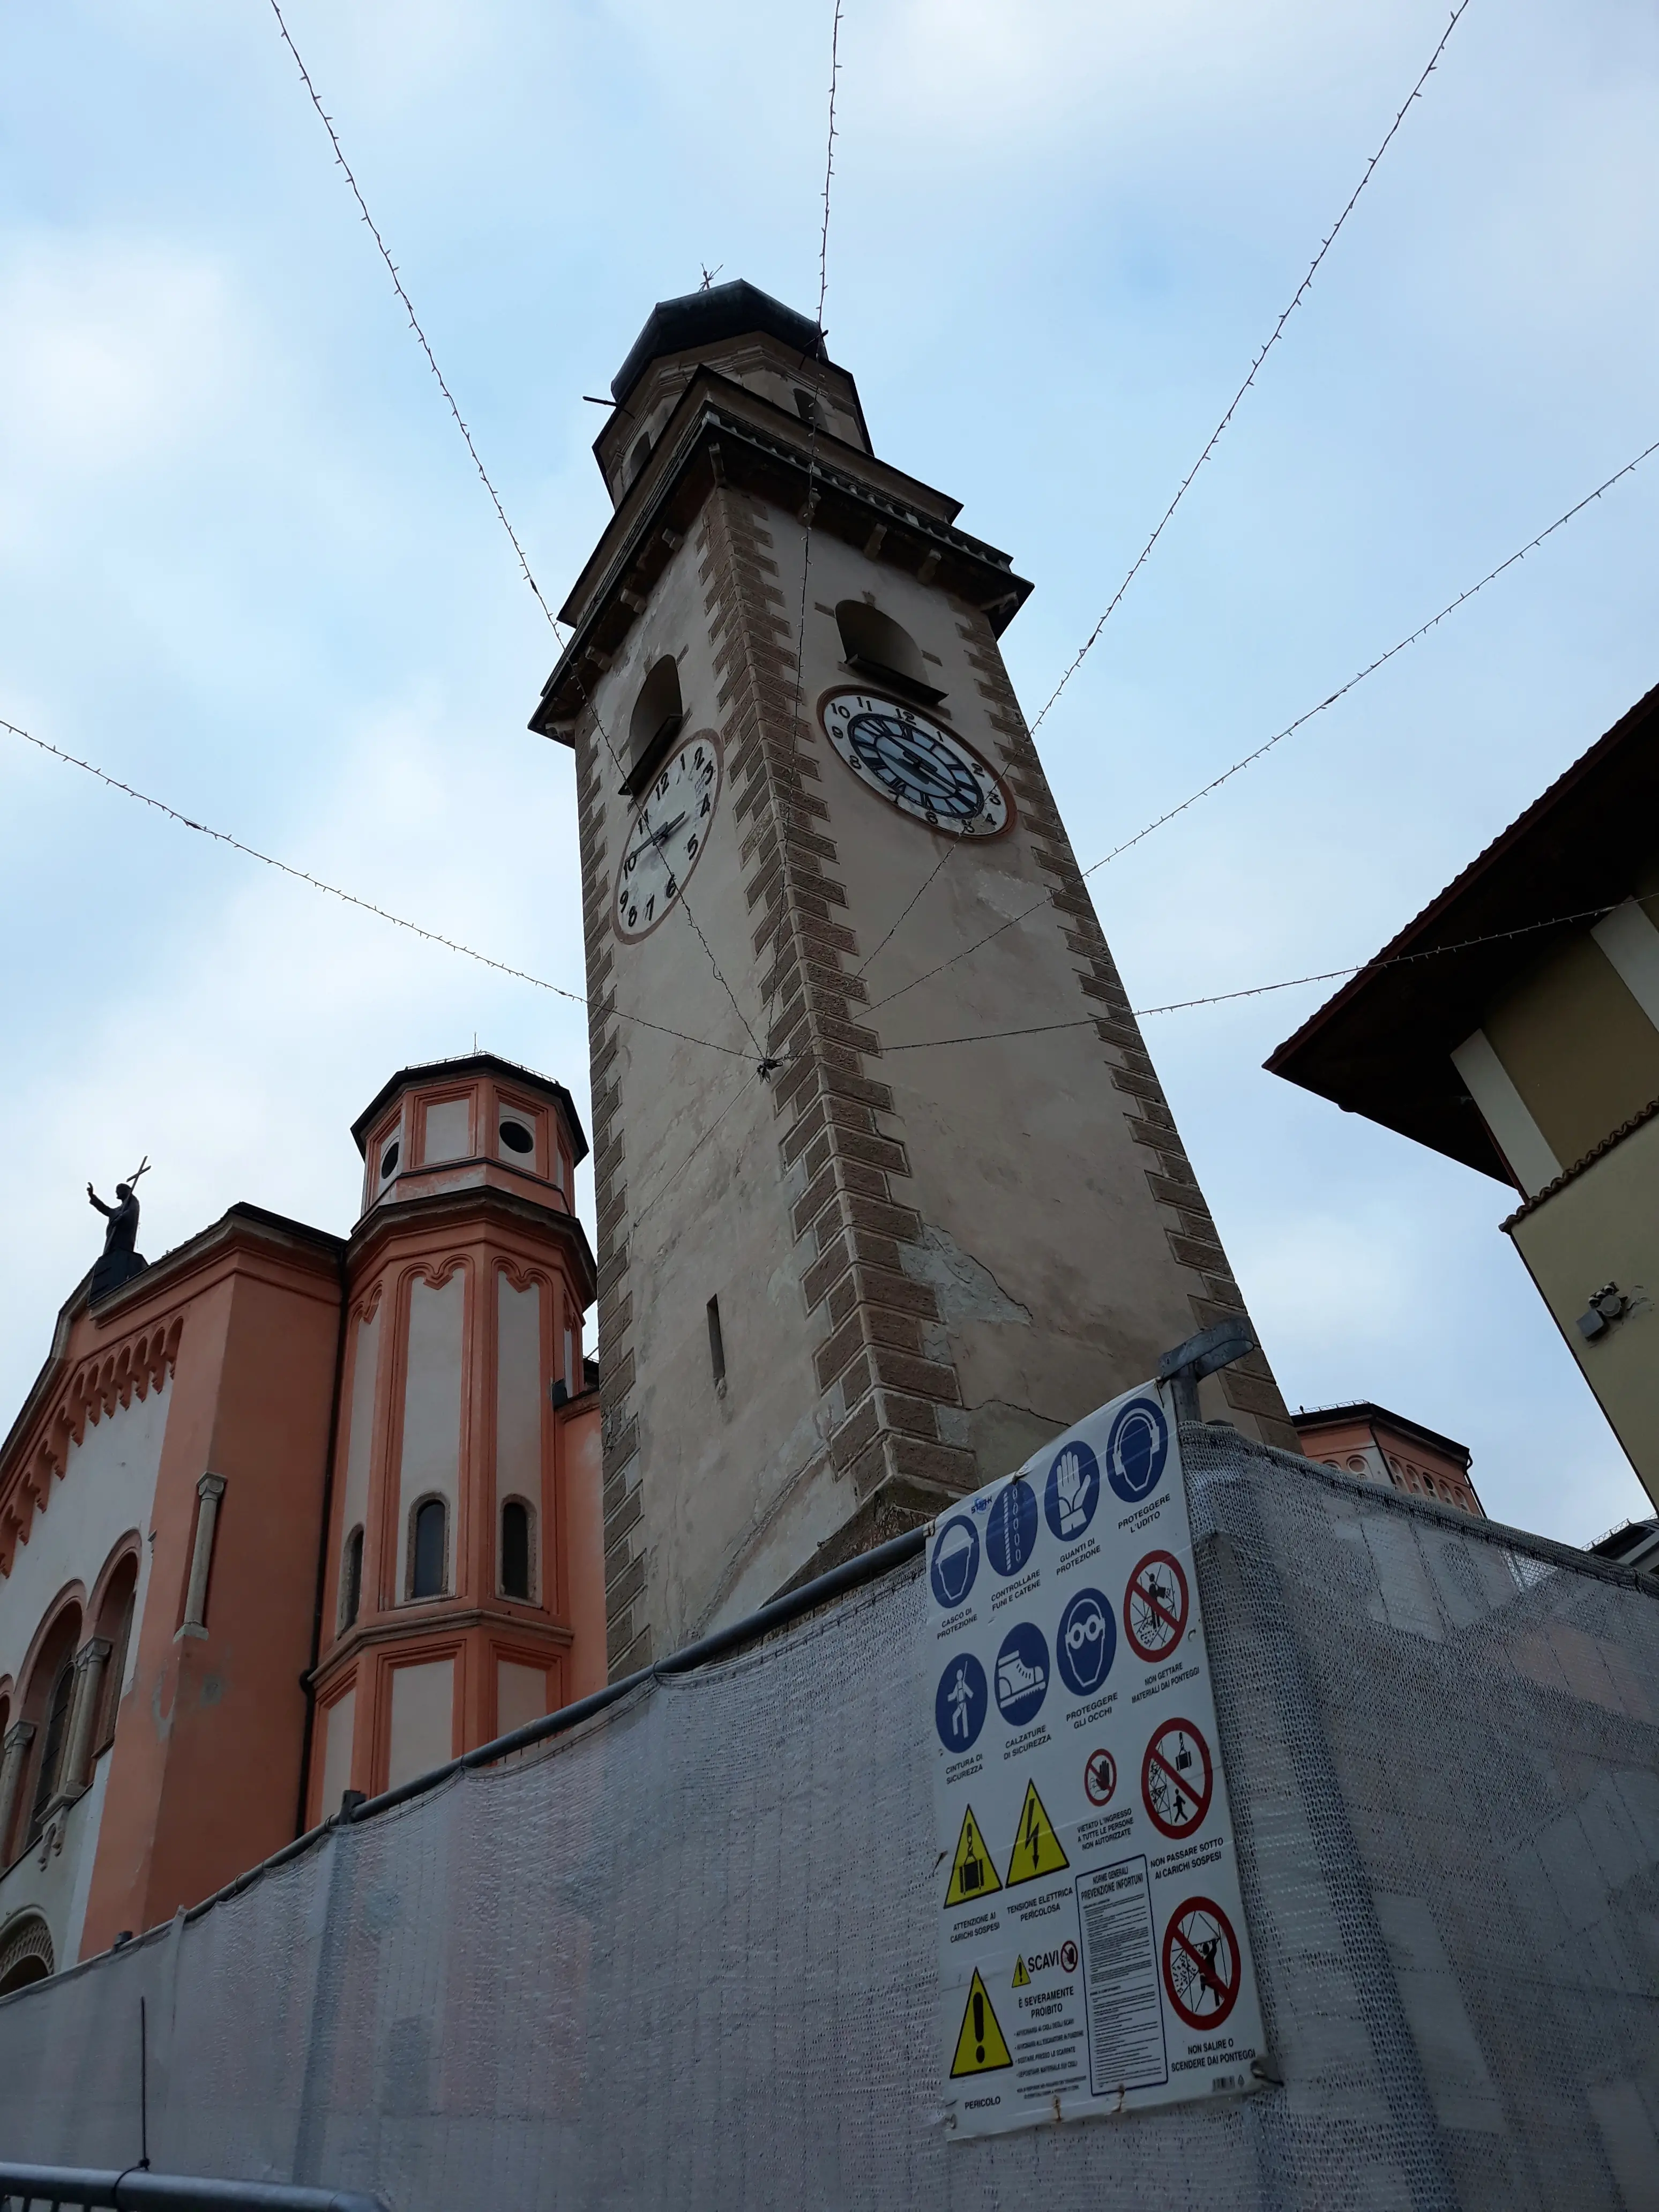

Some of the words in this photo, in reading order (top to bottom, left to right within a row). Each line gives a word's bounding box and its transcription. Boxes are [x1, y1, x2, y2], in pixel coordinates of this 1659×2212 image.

[831, 703, 850, 719] 10
[857, 697, 872, 712] 11
[895, 708, 916, 726] 12
[832, 726, 843, 739] 9
[936, 731, 944, 742] 1
[680, 753, 685, 771] 1
[694, 746, 705, 771] 2
[849, 755, 862, 769] 8
[703, 760, 713, 785] 3
[971, 763, 985, 778] 2
[656, 772, 669, 801] 12
[888, 789, 899, 804] 7
[988, 791, 1001, 805] 3
[700, 793, 711, 817] 4
[638, 808, 649, 835] 11
[926, 811, 938, 824] 6
[961, 819, 975, 833] 5
[986, 813, 997, 825] 4
[687, 833, 698, 860] 5
[623, 851, 637, 880] 10
[666, 874, 676, 898] 6
[620, 890, 629, 913] 9
[646, 893, 654, 921] 7
[628, 906, 637, 927] 8
[1118, 1493, 1171, 1529] PROTEGGERE
[1130, 1511, 1161, 1533] L'UDITO
[1056, 1545, 1101, 1575] PROTEZIONE
[1060, 1542, 1086, 1563] GUANTI
[1088, 1537, 1095, 1546] DI
[991, 1568, 1041, 1602] CONTROLLARE
[992, 1598, 1007, 1611] FUNI
[1015, 1580, 1041, 1598] CATENE
[937, 1613, 977, 1640] PROTEZIONE
[941, 1612, 964, 1627] CASCO
[965, 1607, 972, 1616] DI
[1132, 1684, 1160, 1704] MATERIALI
[1161, 1680, 1170, 1691] DAI
[1171, 1667, 1200, 1686] PONTEGGI
[1145, 1675, 1156, 1686] NON
[1157, 1662, 1183, 1680] GETTARE
[1066, 1692, 1118, 1722] PROTEGGERE
[1074, 1719, 1086, 1729] GLI
[1088, 1706, 1112, 1723] OCCHI
[1004, 1752, 1011, 1760] DI
[1012, 1734, 1051, 1757] SICUREZZA
[1005, 1725, 1047, 1748] CALZATURE
[946, 1757, 974, 1775] CINTURA
[976, 1753, 983, 1761] DI
[946, 1764, 983, 1784] SICUREZZA
[1077, 1821, 1098, 1834] VIETATO
[1082, 1828, 1099, 1841] TUTTE
[1100, 1826, 1107, 1834] LE
[1108, 1817, 1134, 1833] PERSONE
[1082, 1841, 1094, 1851] NON
[1095, 1828, 1131, 1845] AUTORIZZATE
[1150, 1857, 1165, 1869] NON
[1167, 1845, 1198, 1863] PASSARE
[1200, 1837, 1223, 1852] SOTTO
[1155, 1871, 1162, 1880] AI
[1162, 1862, 1190, 1877] CARICHI
[1192, 1850, 1222, 1868] SOSPESI
[1081, 1881, 1115, 1901] PREVENZIONE
[1116, 1873, 1144, 1890] INFORTUNI
[1007, 1898, 1038, 1914] TENSIONE
[1039, 1887, 1073, 1904] ELETTRICA
[953, 1914, 989, 1931] ATTENZIONE
[1020, 1903, 1060, 1922] PERICOLOSA
[950, 1930, 974, 1944] CARICHI
[975, 1922, 1000, 1936] SOSPESI
[1027, 1950, 1059, 1972] SCAVI
[1019, 1997, 1023, 2008] È
[1025, 1986, 1074, 2007] SEVERAMENTE
[1031, 2003, 1063, 2019] PROIBITO
[1188, 2043, 1202, 2055] NON
[1203, 2039, 1227, 2052] SALIRE
[1228, 2038, 1234, 2047] O
[1171, 2058, 1206, 2072] SCENDERE
[1207, 2056, 1219, 2066] DAI
[1220, 2048, 1256, 2064] PONTEGGI
[965, 2096, 1001, 2110] PERICOLO
